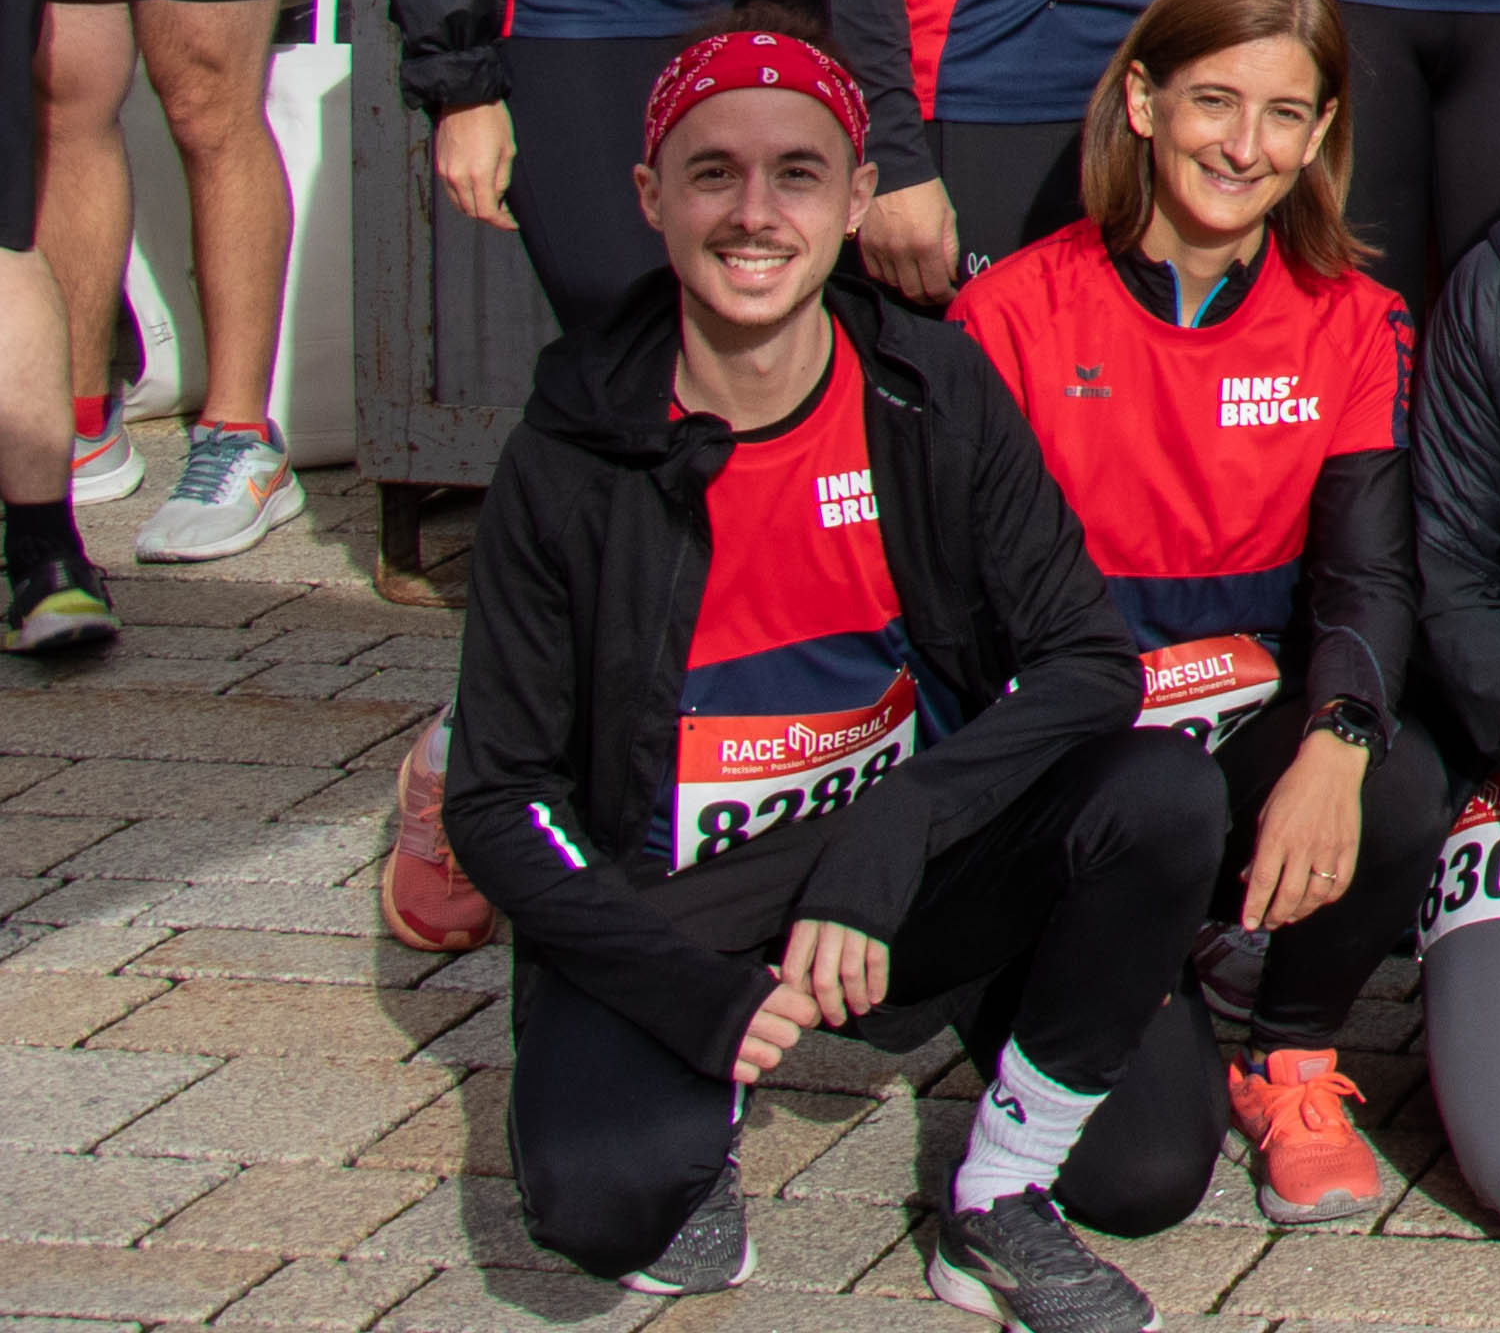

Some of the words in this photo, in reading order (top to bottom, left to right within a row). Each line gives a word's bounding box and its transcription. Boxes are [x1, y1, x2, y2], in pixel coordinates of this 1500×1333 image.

[1219, 376, 1300, 402] INNS'
[1218, 396, 1321, 428] BRUCK
[1157, 652, 1235, 692] RESULT
[721, 737, 787, 763] RACE
[818, 705, 893, 753] RESULT
[722, 764, 764, 776] Precision
[770, 759, 806, 772] Passion
